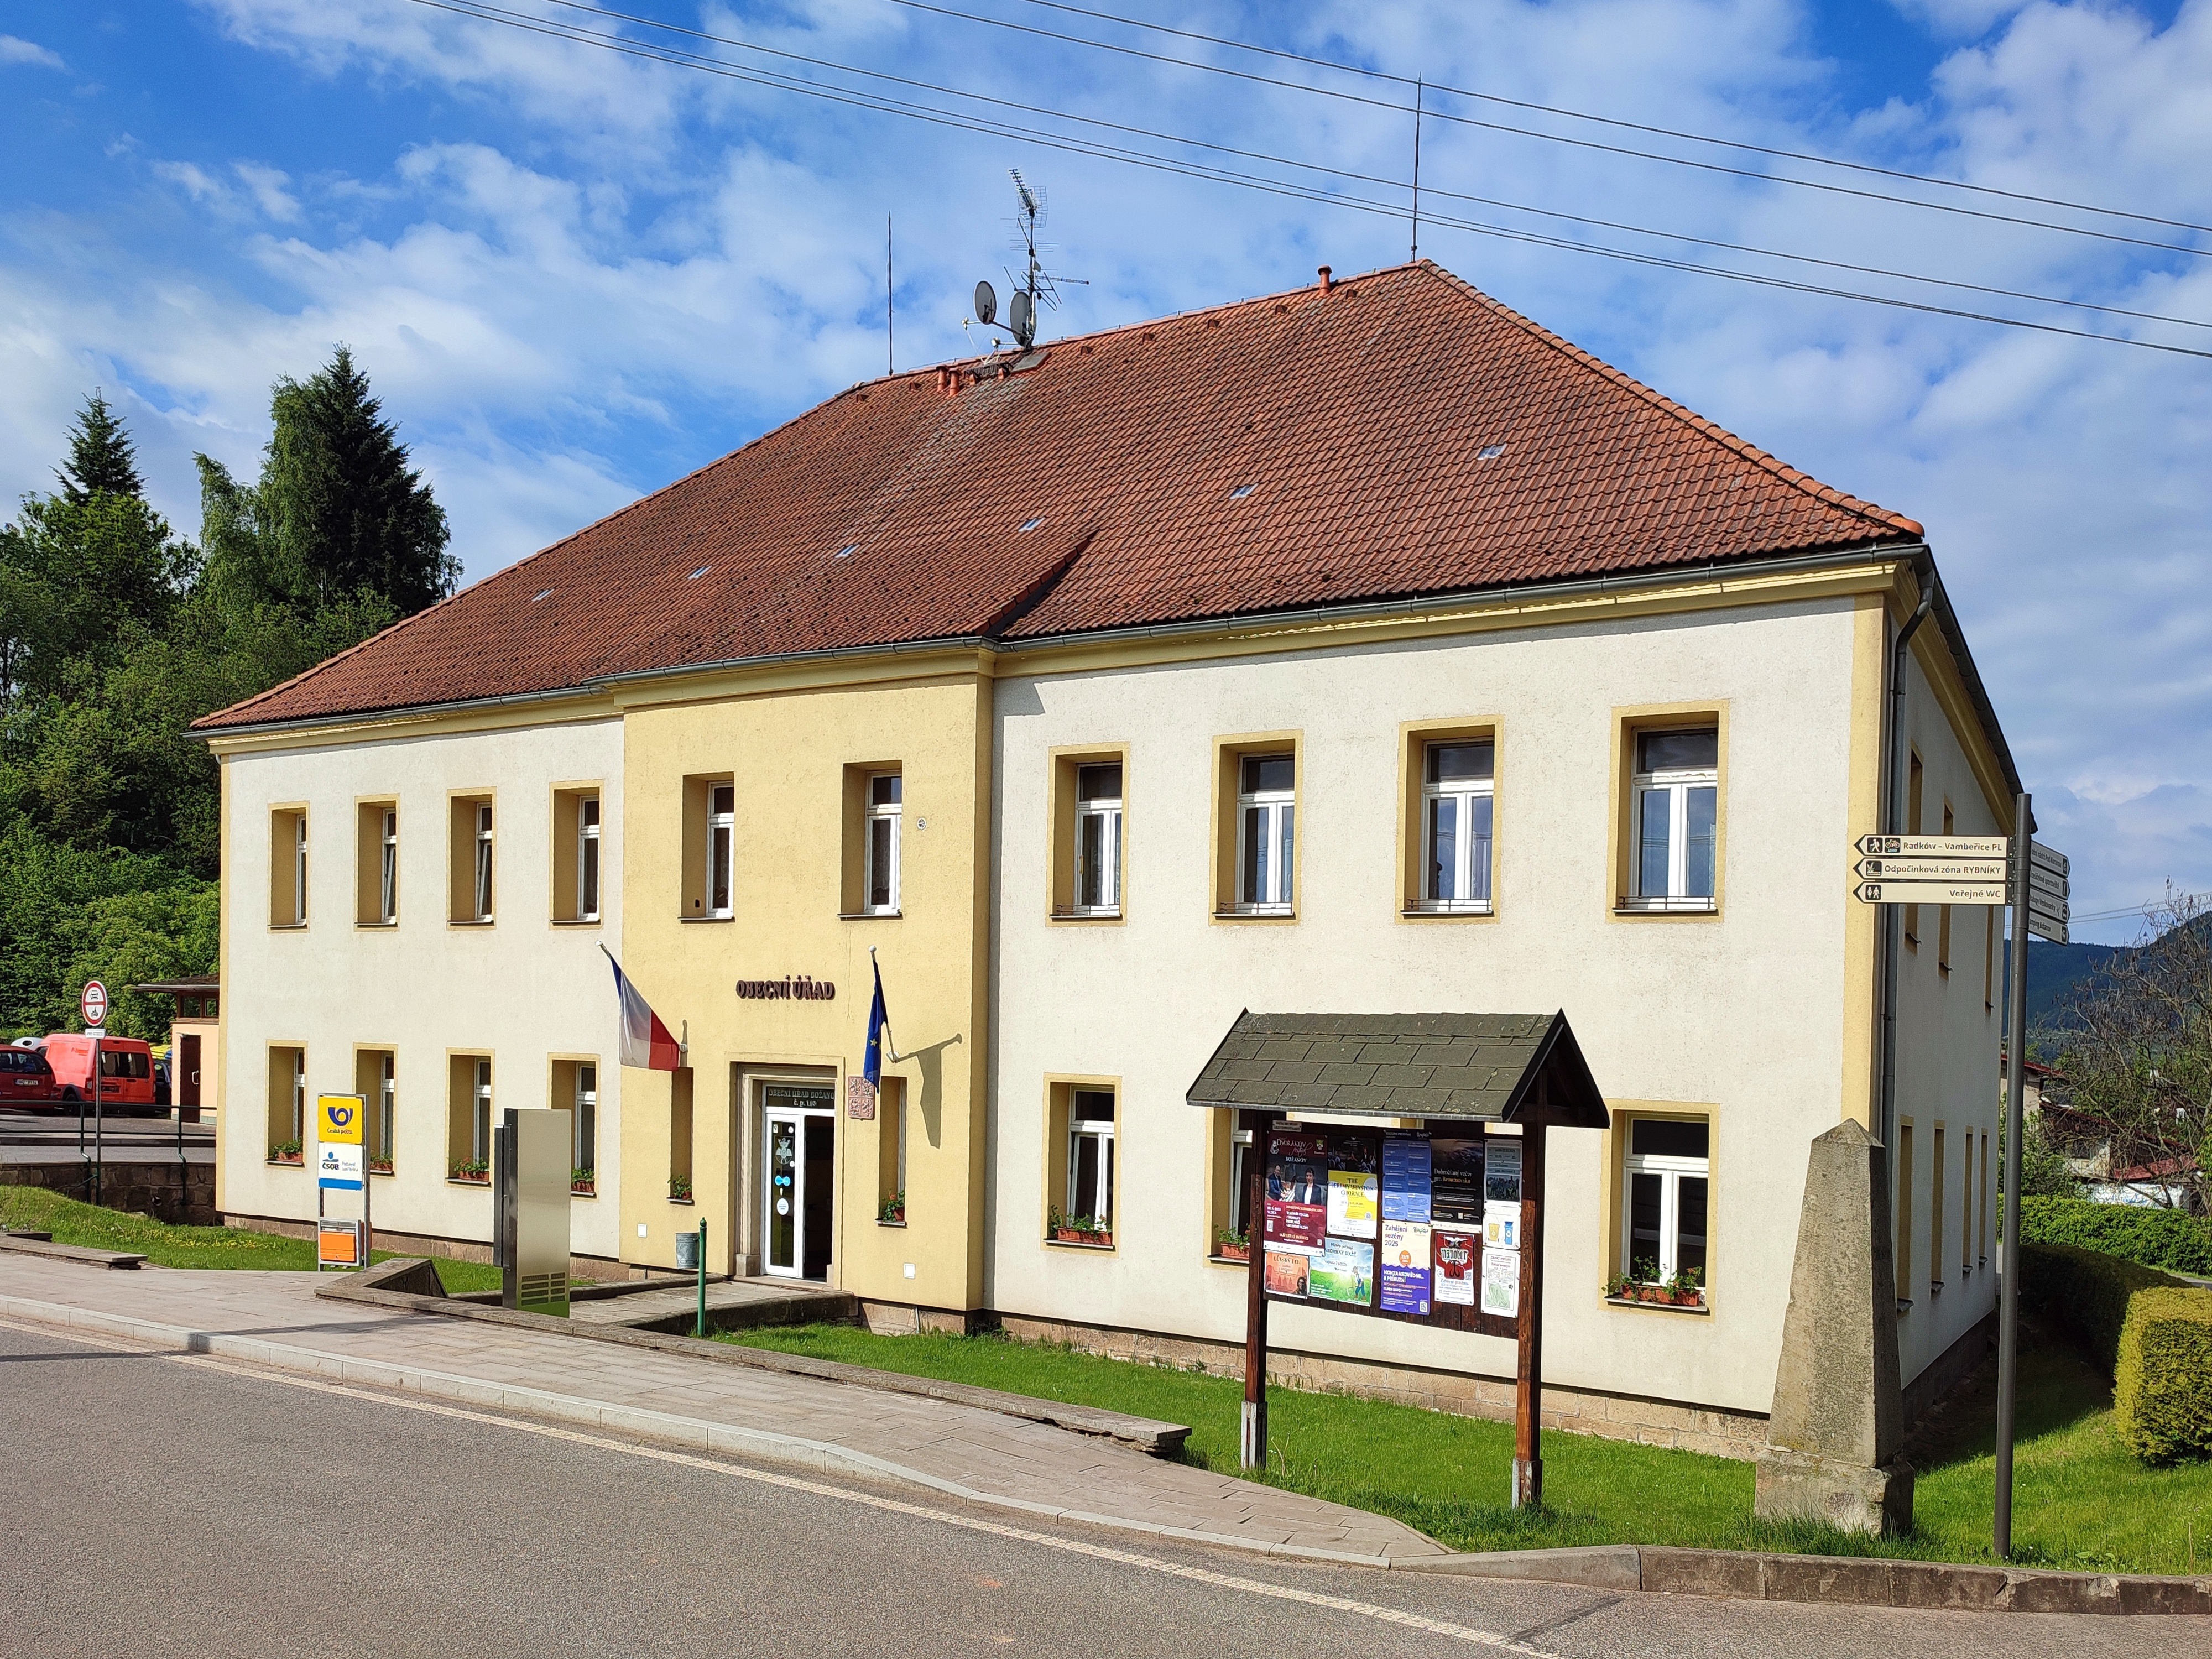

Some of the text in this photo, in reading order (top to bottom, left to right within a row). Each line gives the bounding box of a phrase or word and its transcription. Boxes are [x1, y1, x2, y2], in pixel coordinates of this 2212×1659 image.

[1903, 841, 1936, 850] Radków
[1944, 842, 1990, 851] Vambeřice
[1885, 864, 1939, 874] Odpočinková
[1964, 865, 2001, 874] RYBNÍKY
[1949, 889, 1984, 899] Veřejné
[736, 974, 836, 1000] OBECNÍ ÚŘAD
[769, 1088, 834, 1099] OBECNÍ ÚŘAD BOŽANO
[322, 1162, 340, 1170] ČSOB
[1385, 1224, 1408, 1233] Zahájení
[1385, 1233, 1404, 1241] sezóny
